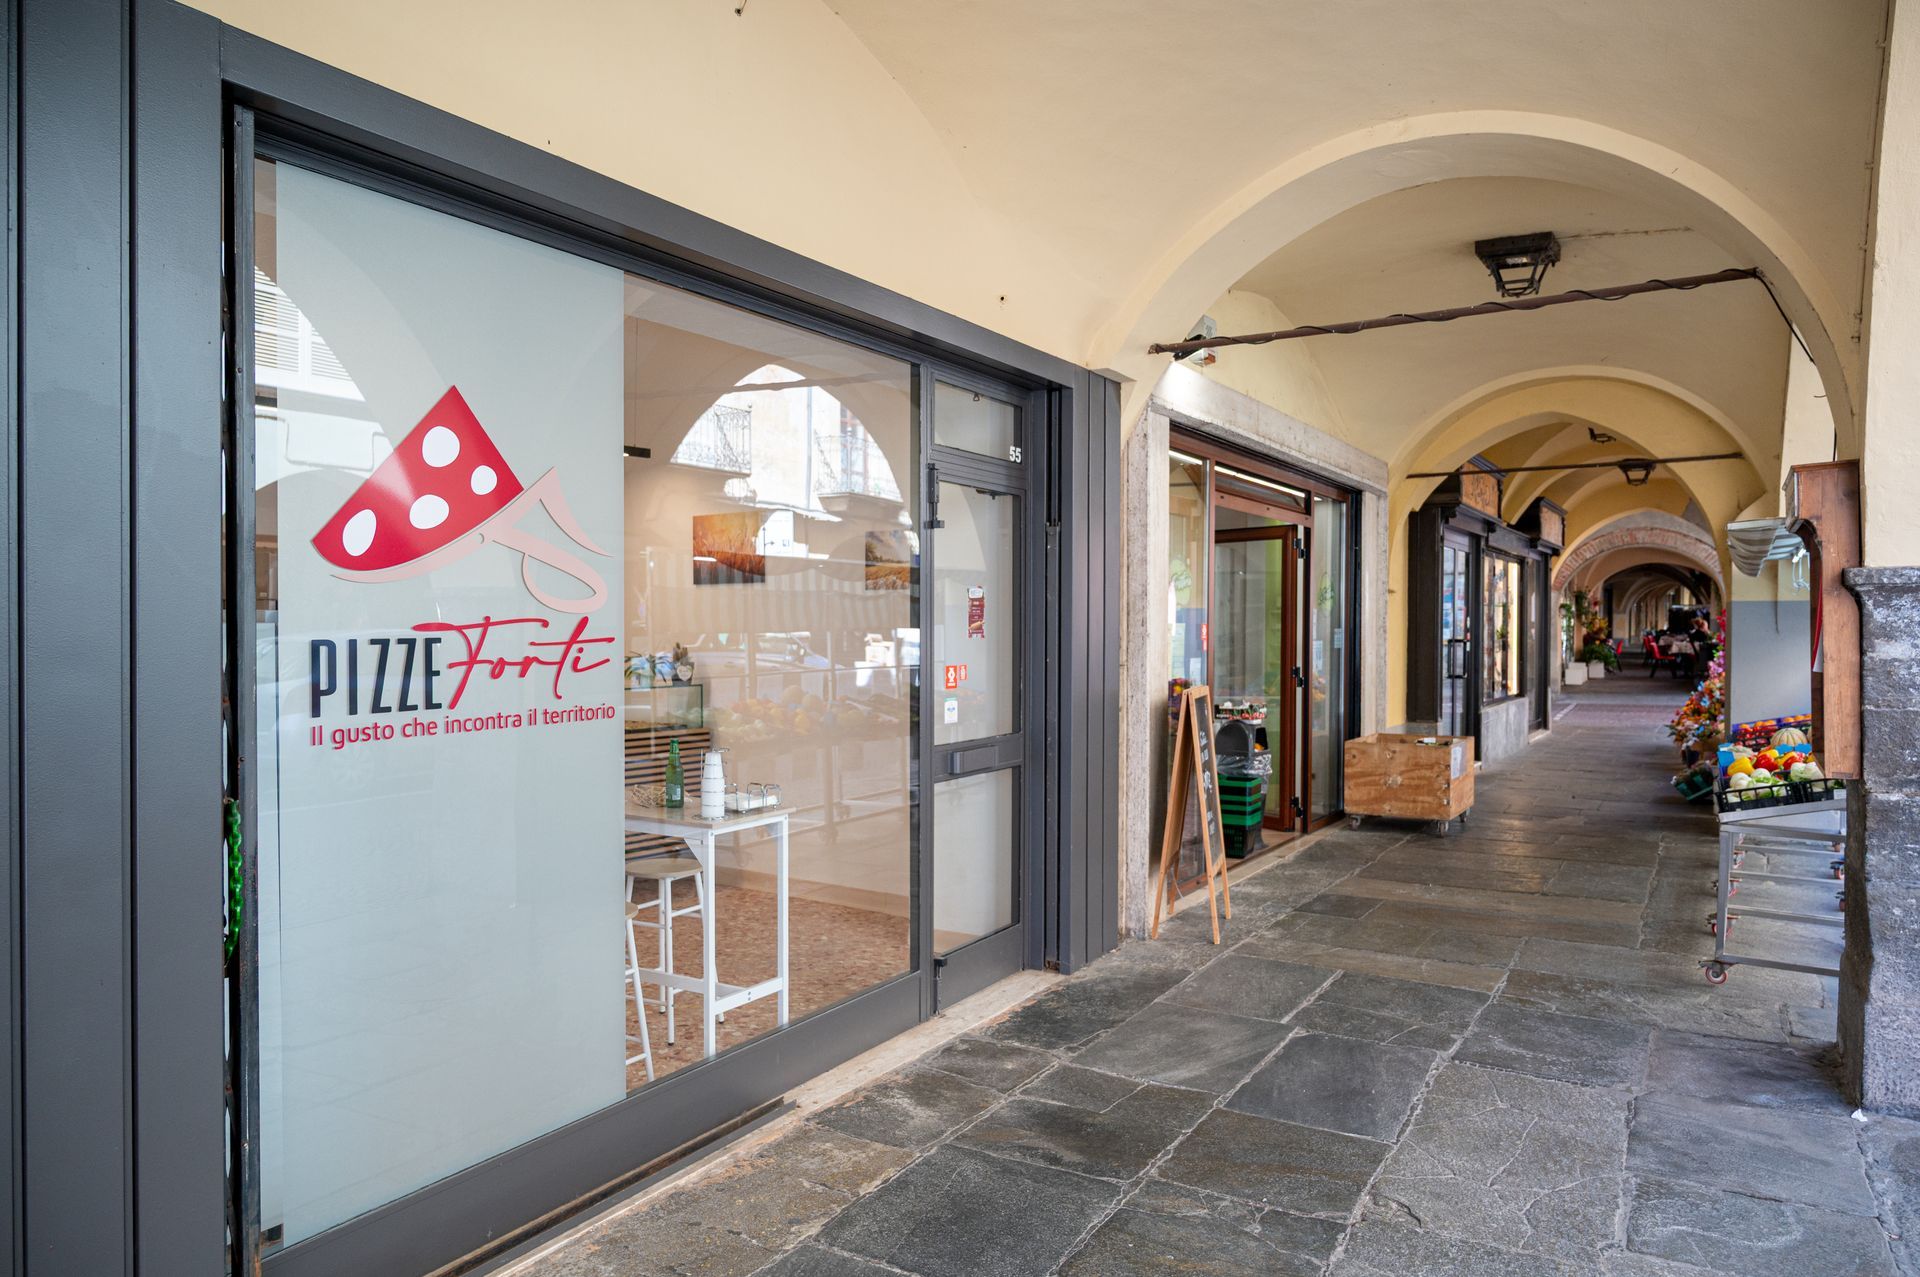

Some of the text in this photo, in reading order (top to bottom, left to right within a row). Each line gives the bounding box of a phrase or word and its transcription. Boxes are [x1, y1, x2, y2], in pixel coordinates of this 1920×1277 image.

[1009, 445, 1021, 463] 55
[310, 616, 616, 718] PIZZE Forti
[311, 704, 616, 750] Il gusto che incontra il territorio
